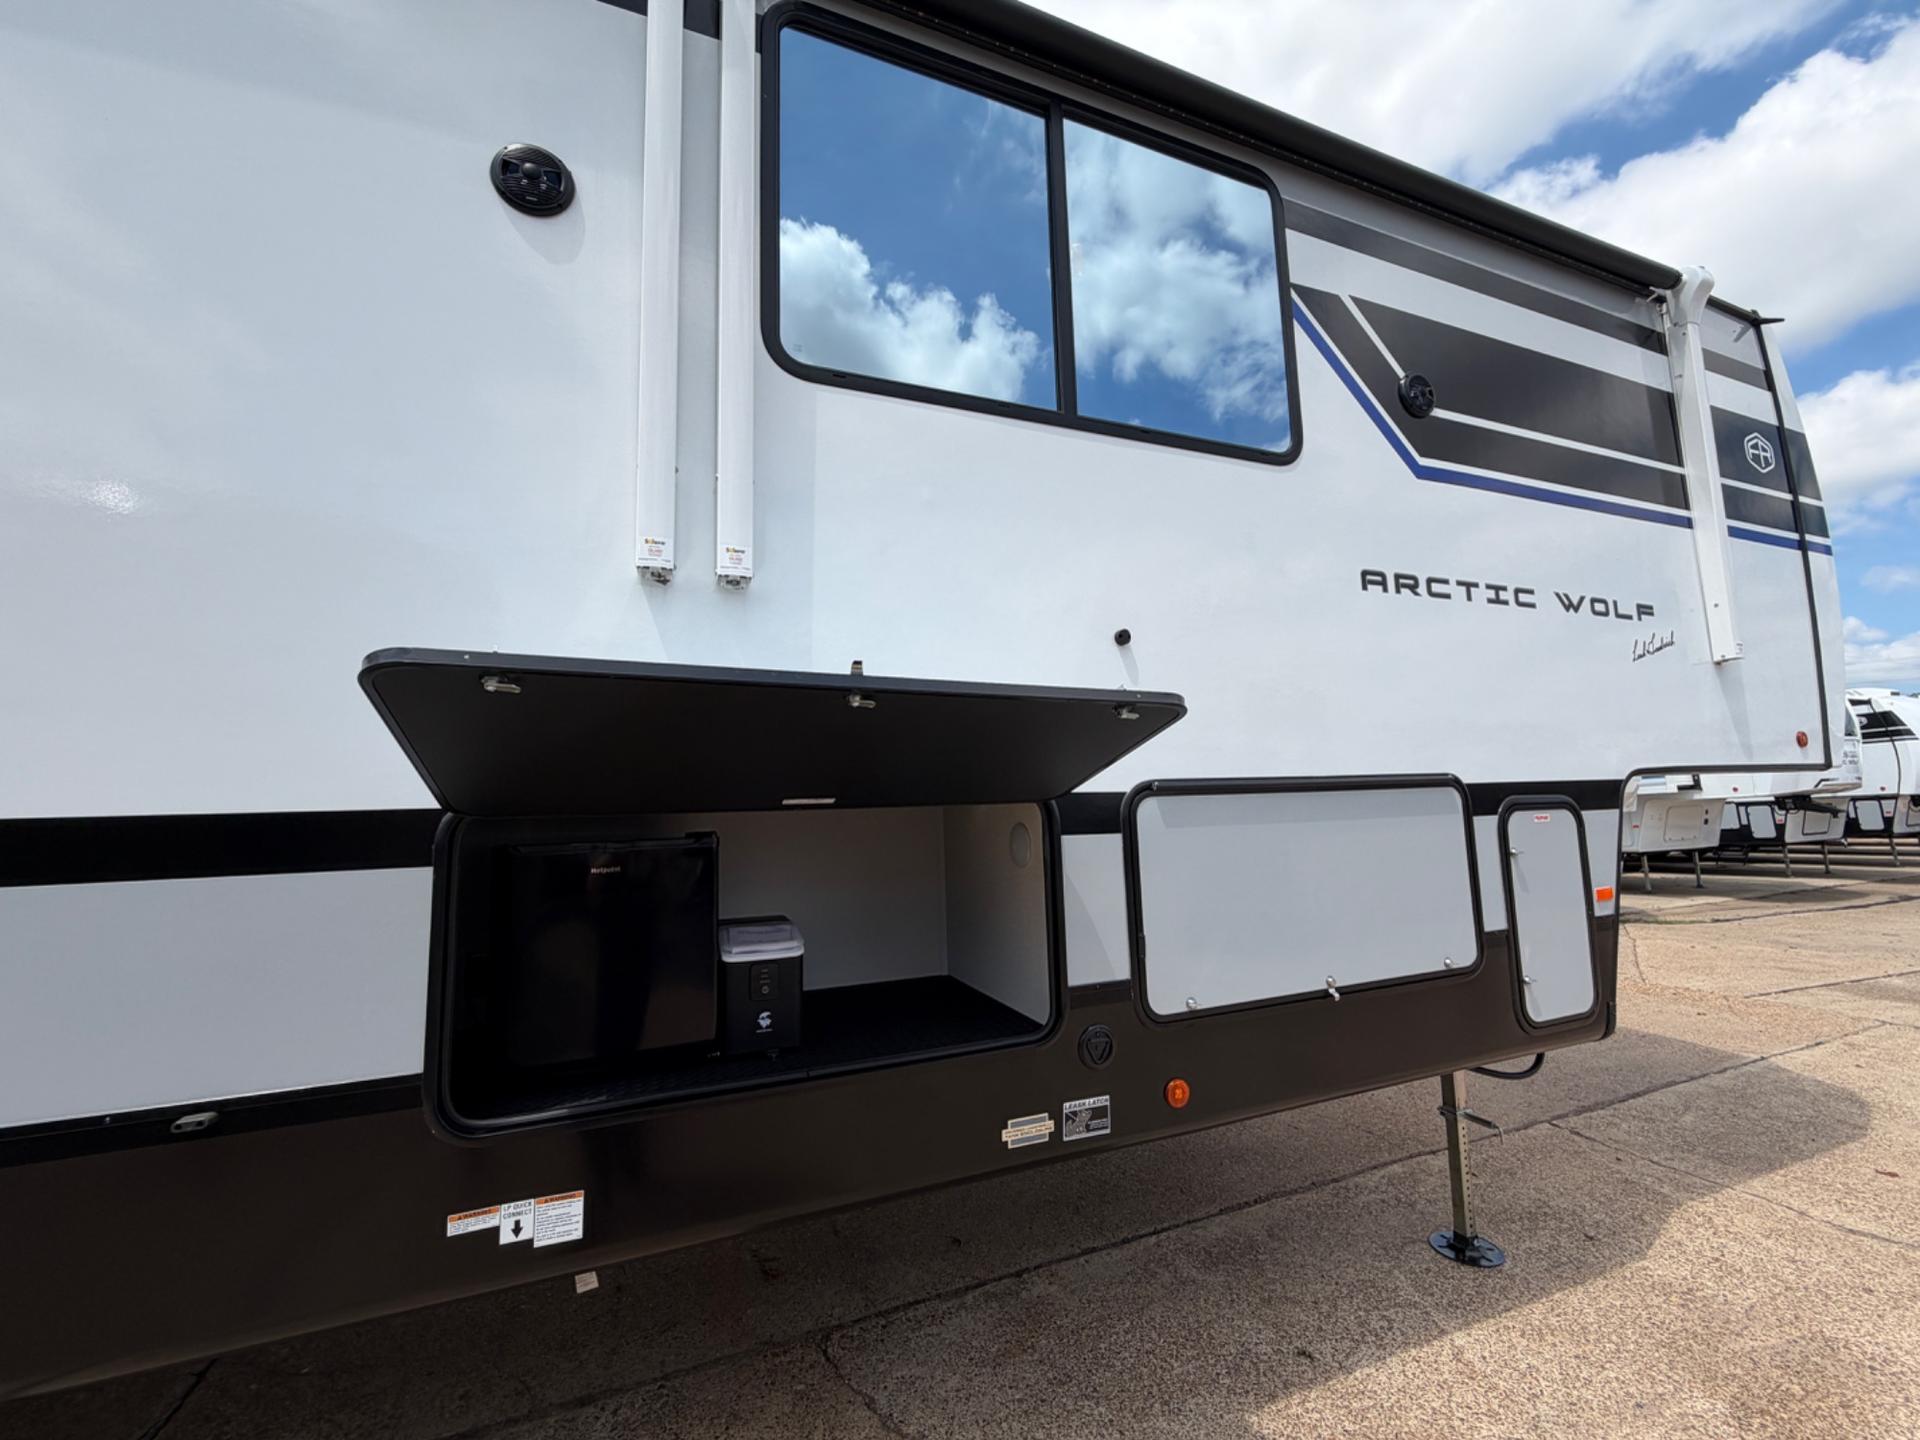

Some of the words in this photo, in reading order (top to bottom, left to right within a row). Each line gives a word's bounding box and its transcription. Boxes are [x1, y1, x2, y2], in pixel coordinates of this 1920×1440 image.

[1360, 569, 1537, 609] ARCTIC
[1553, 591, 1655, 621] WOLF
[503, 1208, 532, 1219] CONNECT
